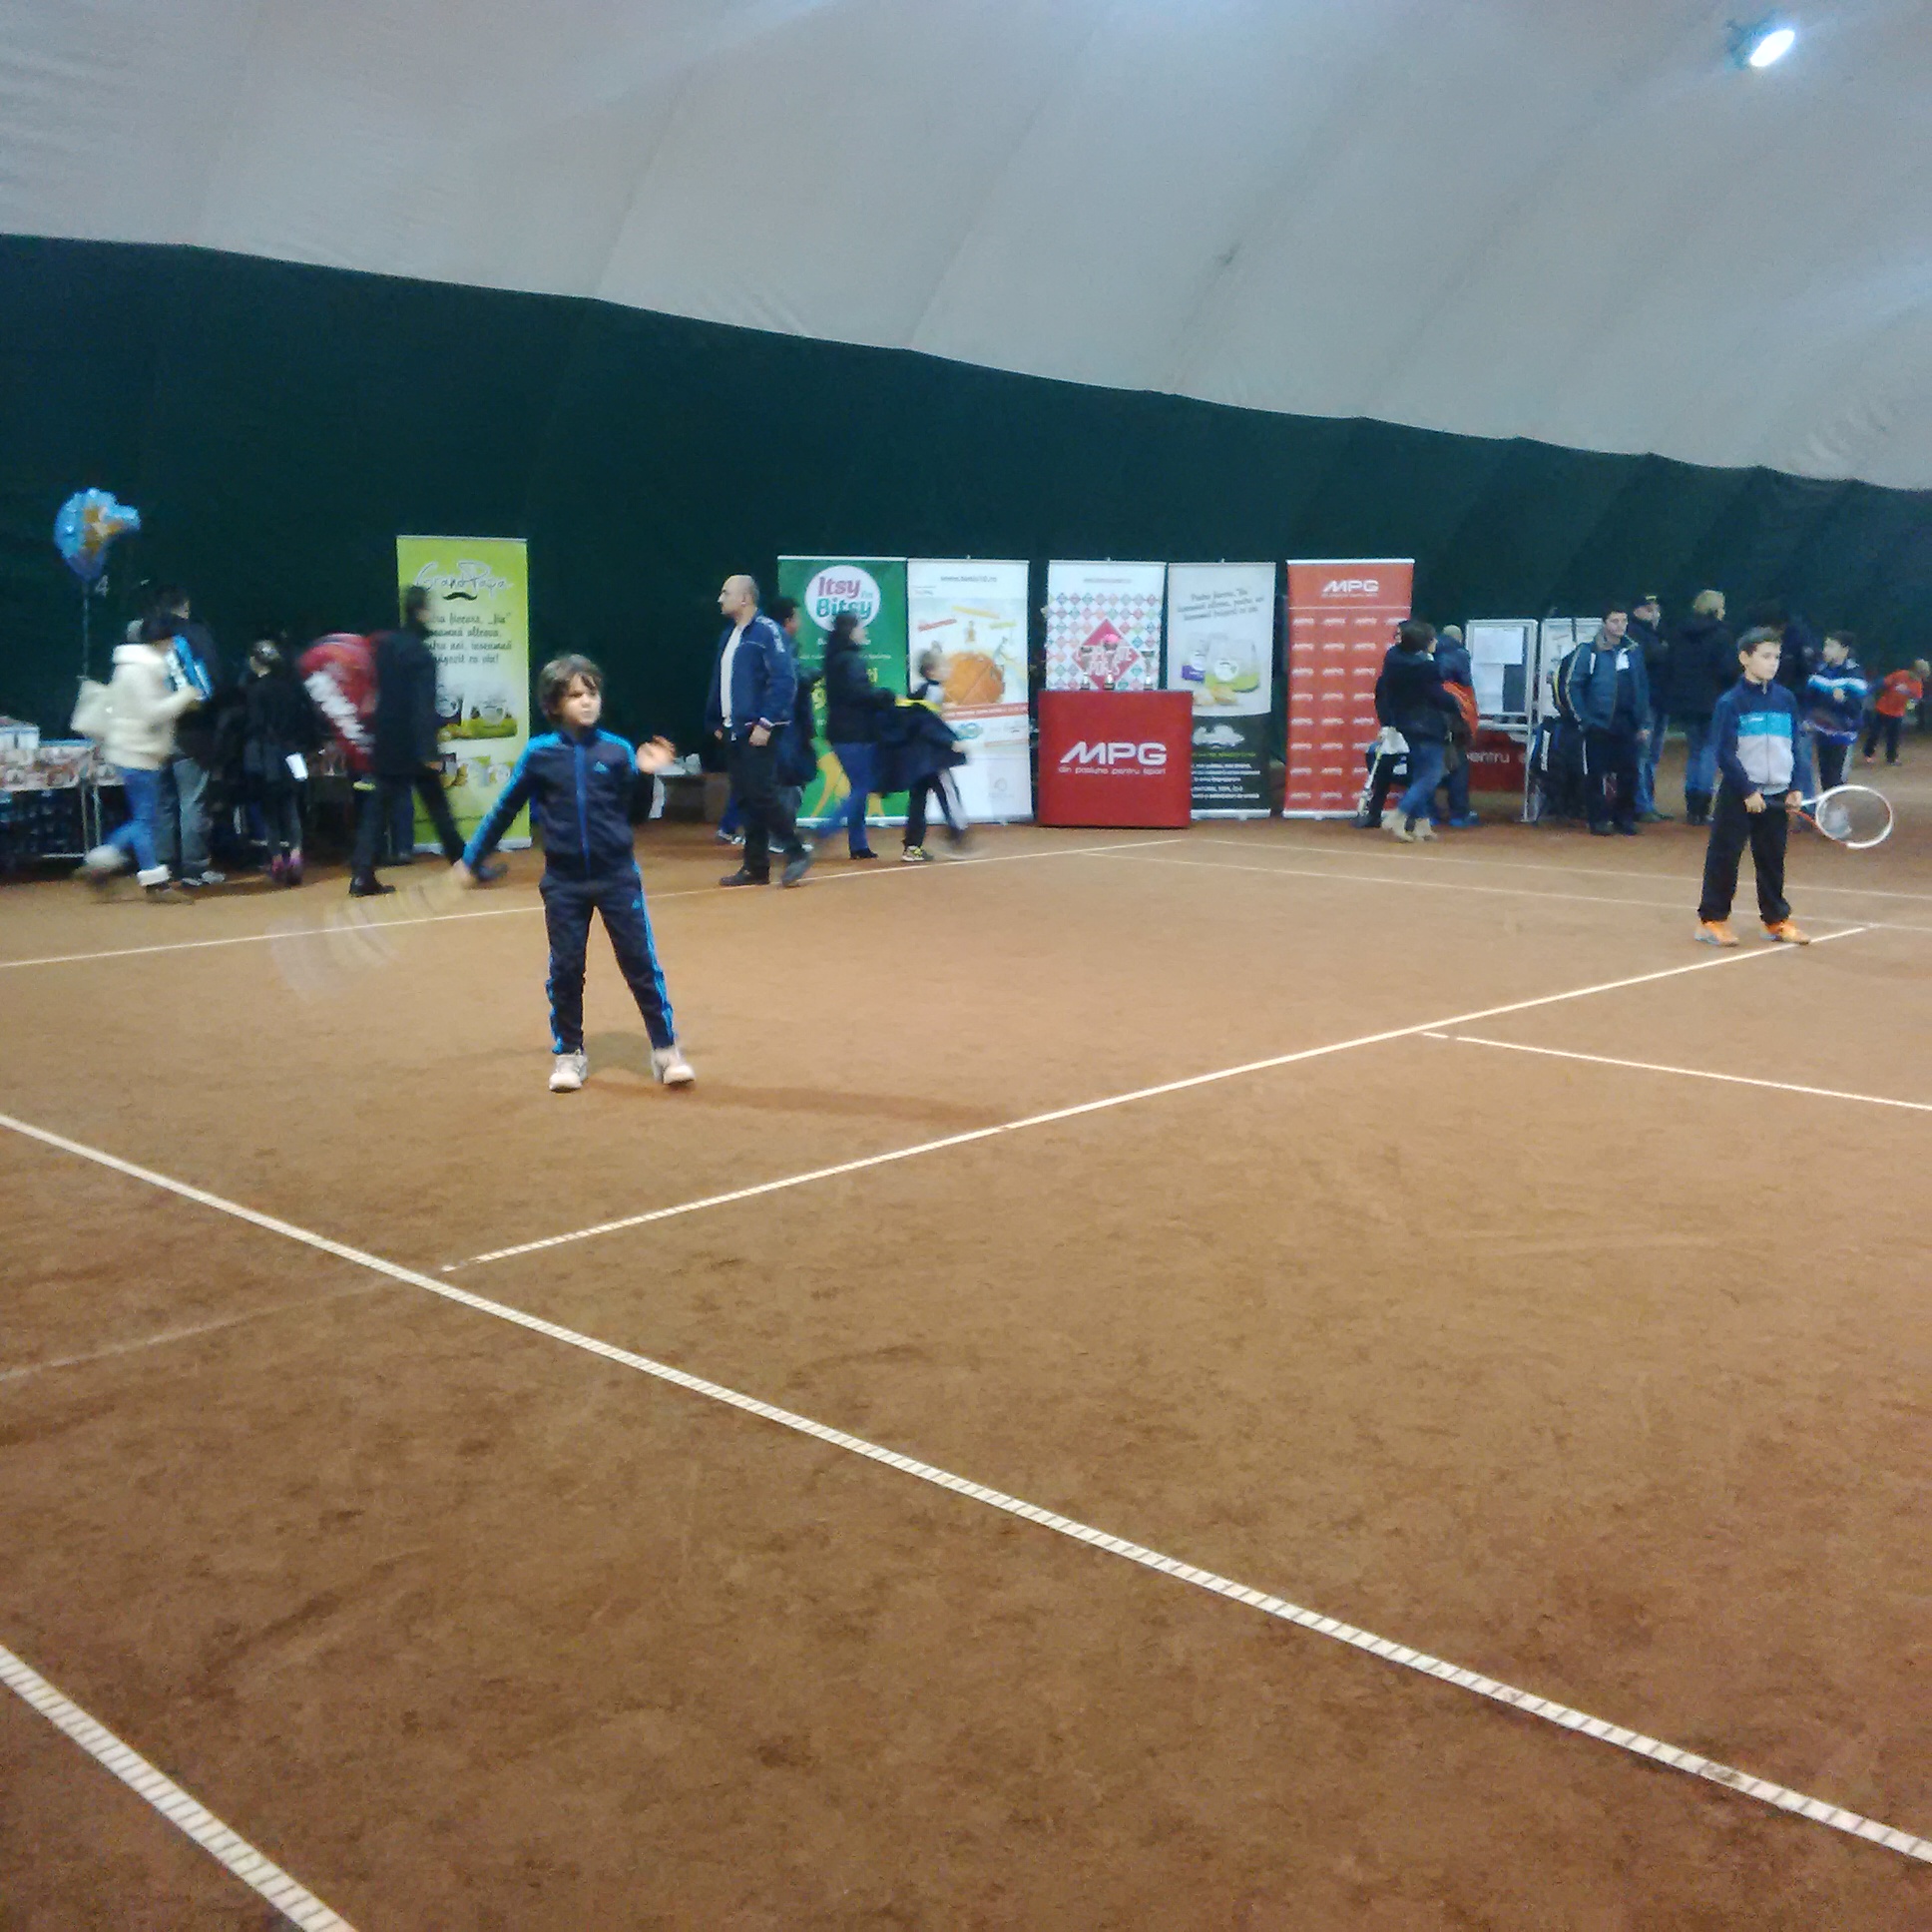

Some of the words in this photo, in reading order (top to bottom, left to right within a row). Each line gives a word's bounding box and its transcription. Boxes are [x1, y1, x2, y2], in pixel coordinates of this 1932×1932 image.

[817, 577, 860, 599] Itsy
[1322, 580, 1379, 593] MPG
[1059, 740, 1168, 766] MPG
